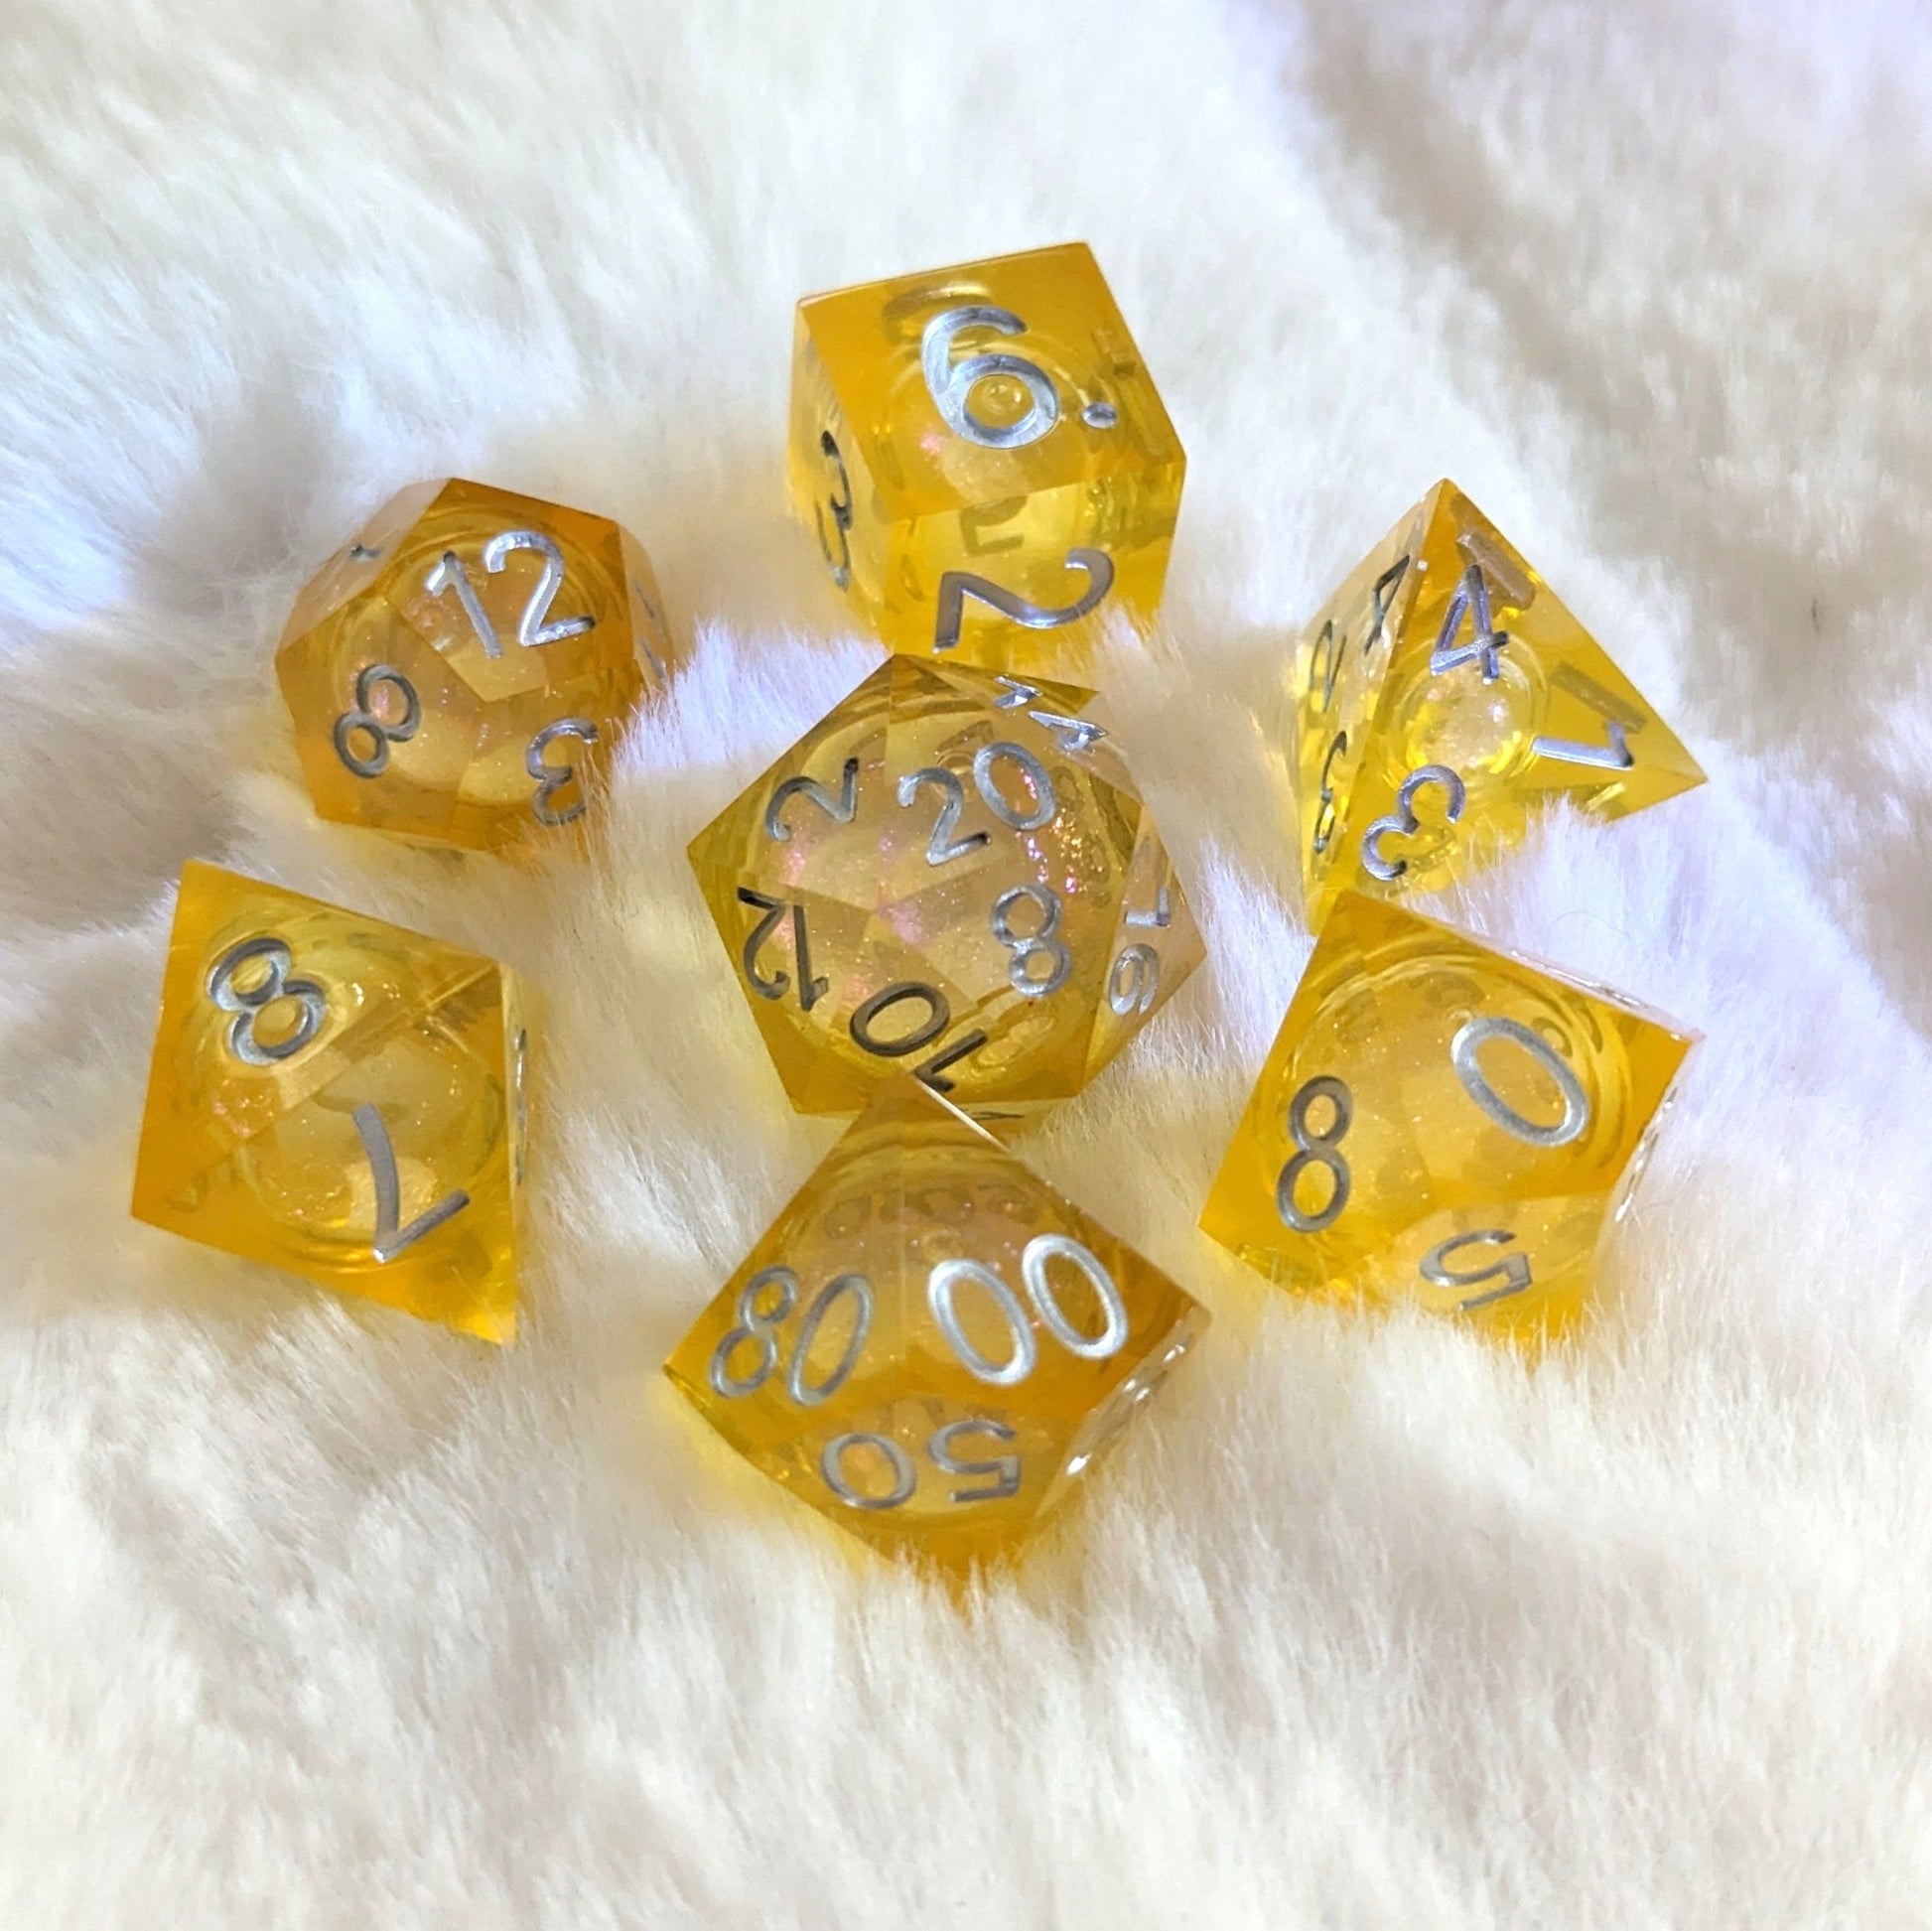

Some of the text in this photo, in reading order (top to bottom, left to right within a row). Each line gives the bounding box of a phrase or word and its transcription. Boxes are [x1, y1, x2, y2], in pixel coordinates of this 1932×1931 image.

[425, 529, 597, 659] 12
[933, 547, 1115, 653] 2
[1430, 563, 1509, 686] 4
[333, 662, 422, 779] 8
[525, 716, 599, 827] 3
[1531, 720, 1635, 770] 1
[763, 757, 860, 843] 2
[897, 741, 1056, 867] 20
[1361, 763, 1466, 882] 3
[738, 887, 828, 1013] 12
[991, 881, 1073, 998] 8
[207, 935, 328, 1067] 8
[850, 980, 989, 1093] 10
[1450, 1016, 1590, 1149] 0
[352, 1102, 471, 1264] 7
[1276, 1074, 1354, 1234] 8
[927, 1232, 1130, 1386] 00
[1419, 1228, 1534, 1312] 5
[710, 1264, 876, 1408] 80
[821, 1419, 1023, 1510] 50
